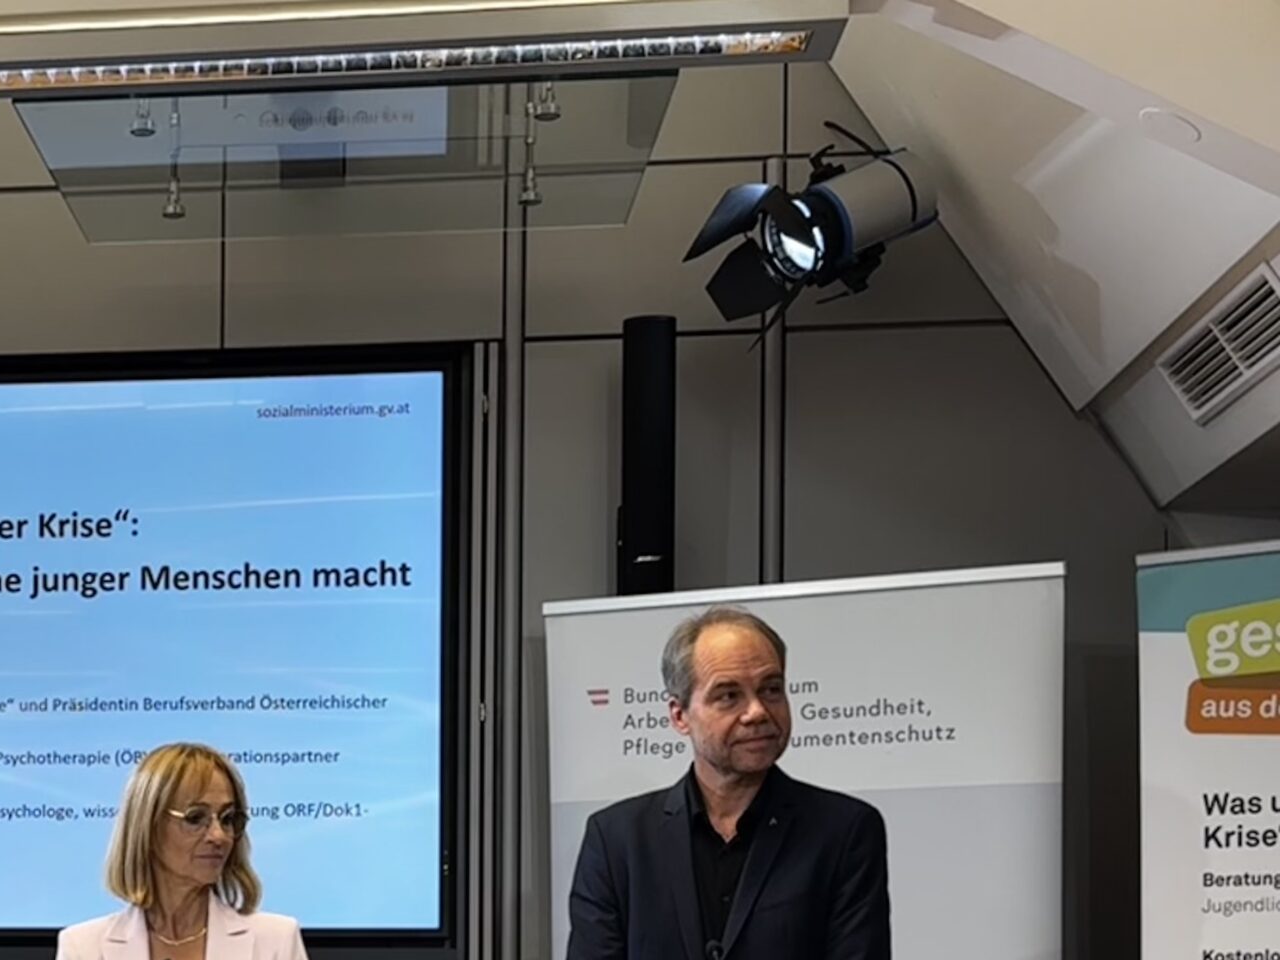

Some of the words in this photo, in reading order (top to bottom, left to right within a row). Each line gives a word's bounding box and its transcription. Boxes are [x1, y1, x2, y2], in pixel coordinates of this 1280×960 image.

[256, 402, 411, 420] sozialministerium.gv.at
[30, 566, 130, 599] junger
[140, 562, 301, 590] Menschen
[312, 560, 412, 588] macht
[1206, 619, 1280, 676] ge
[20, 698, 48, 712] und
[52, 697, 138, 712] Präsidentin
[143, 696, 256, 711] Berufsverband
[259, 693, 388, 710] Österreichischer
[623, 712, 669, 730] Arbe
[800, 698, 932, 721] Gesundheit,
[1200, 699, 1252, 719] aus
[1259, 694, 1280, 718] d
[623, 738, 686, 760] Pflege
[791, 724, 956, 748] umentenschutz
[228, 751, 340, 766] rationspartner
[284, 802, 369, 819] ORF/Dok1-
[1203, 792, 1263, 816] Was
[1203, 824, 1280, 849] Krise
